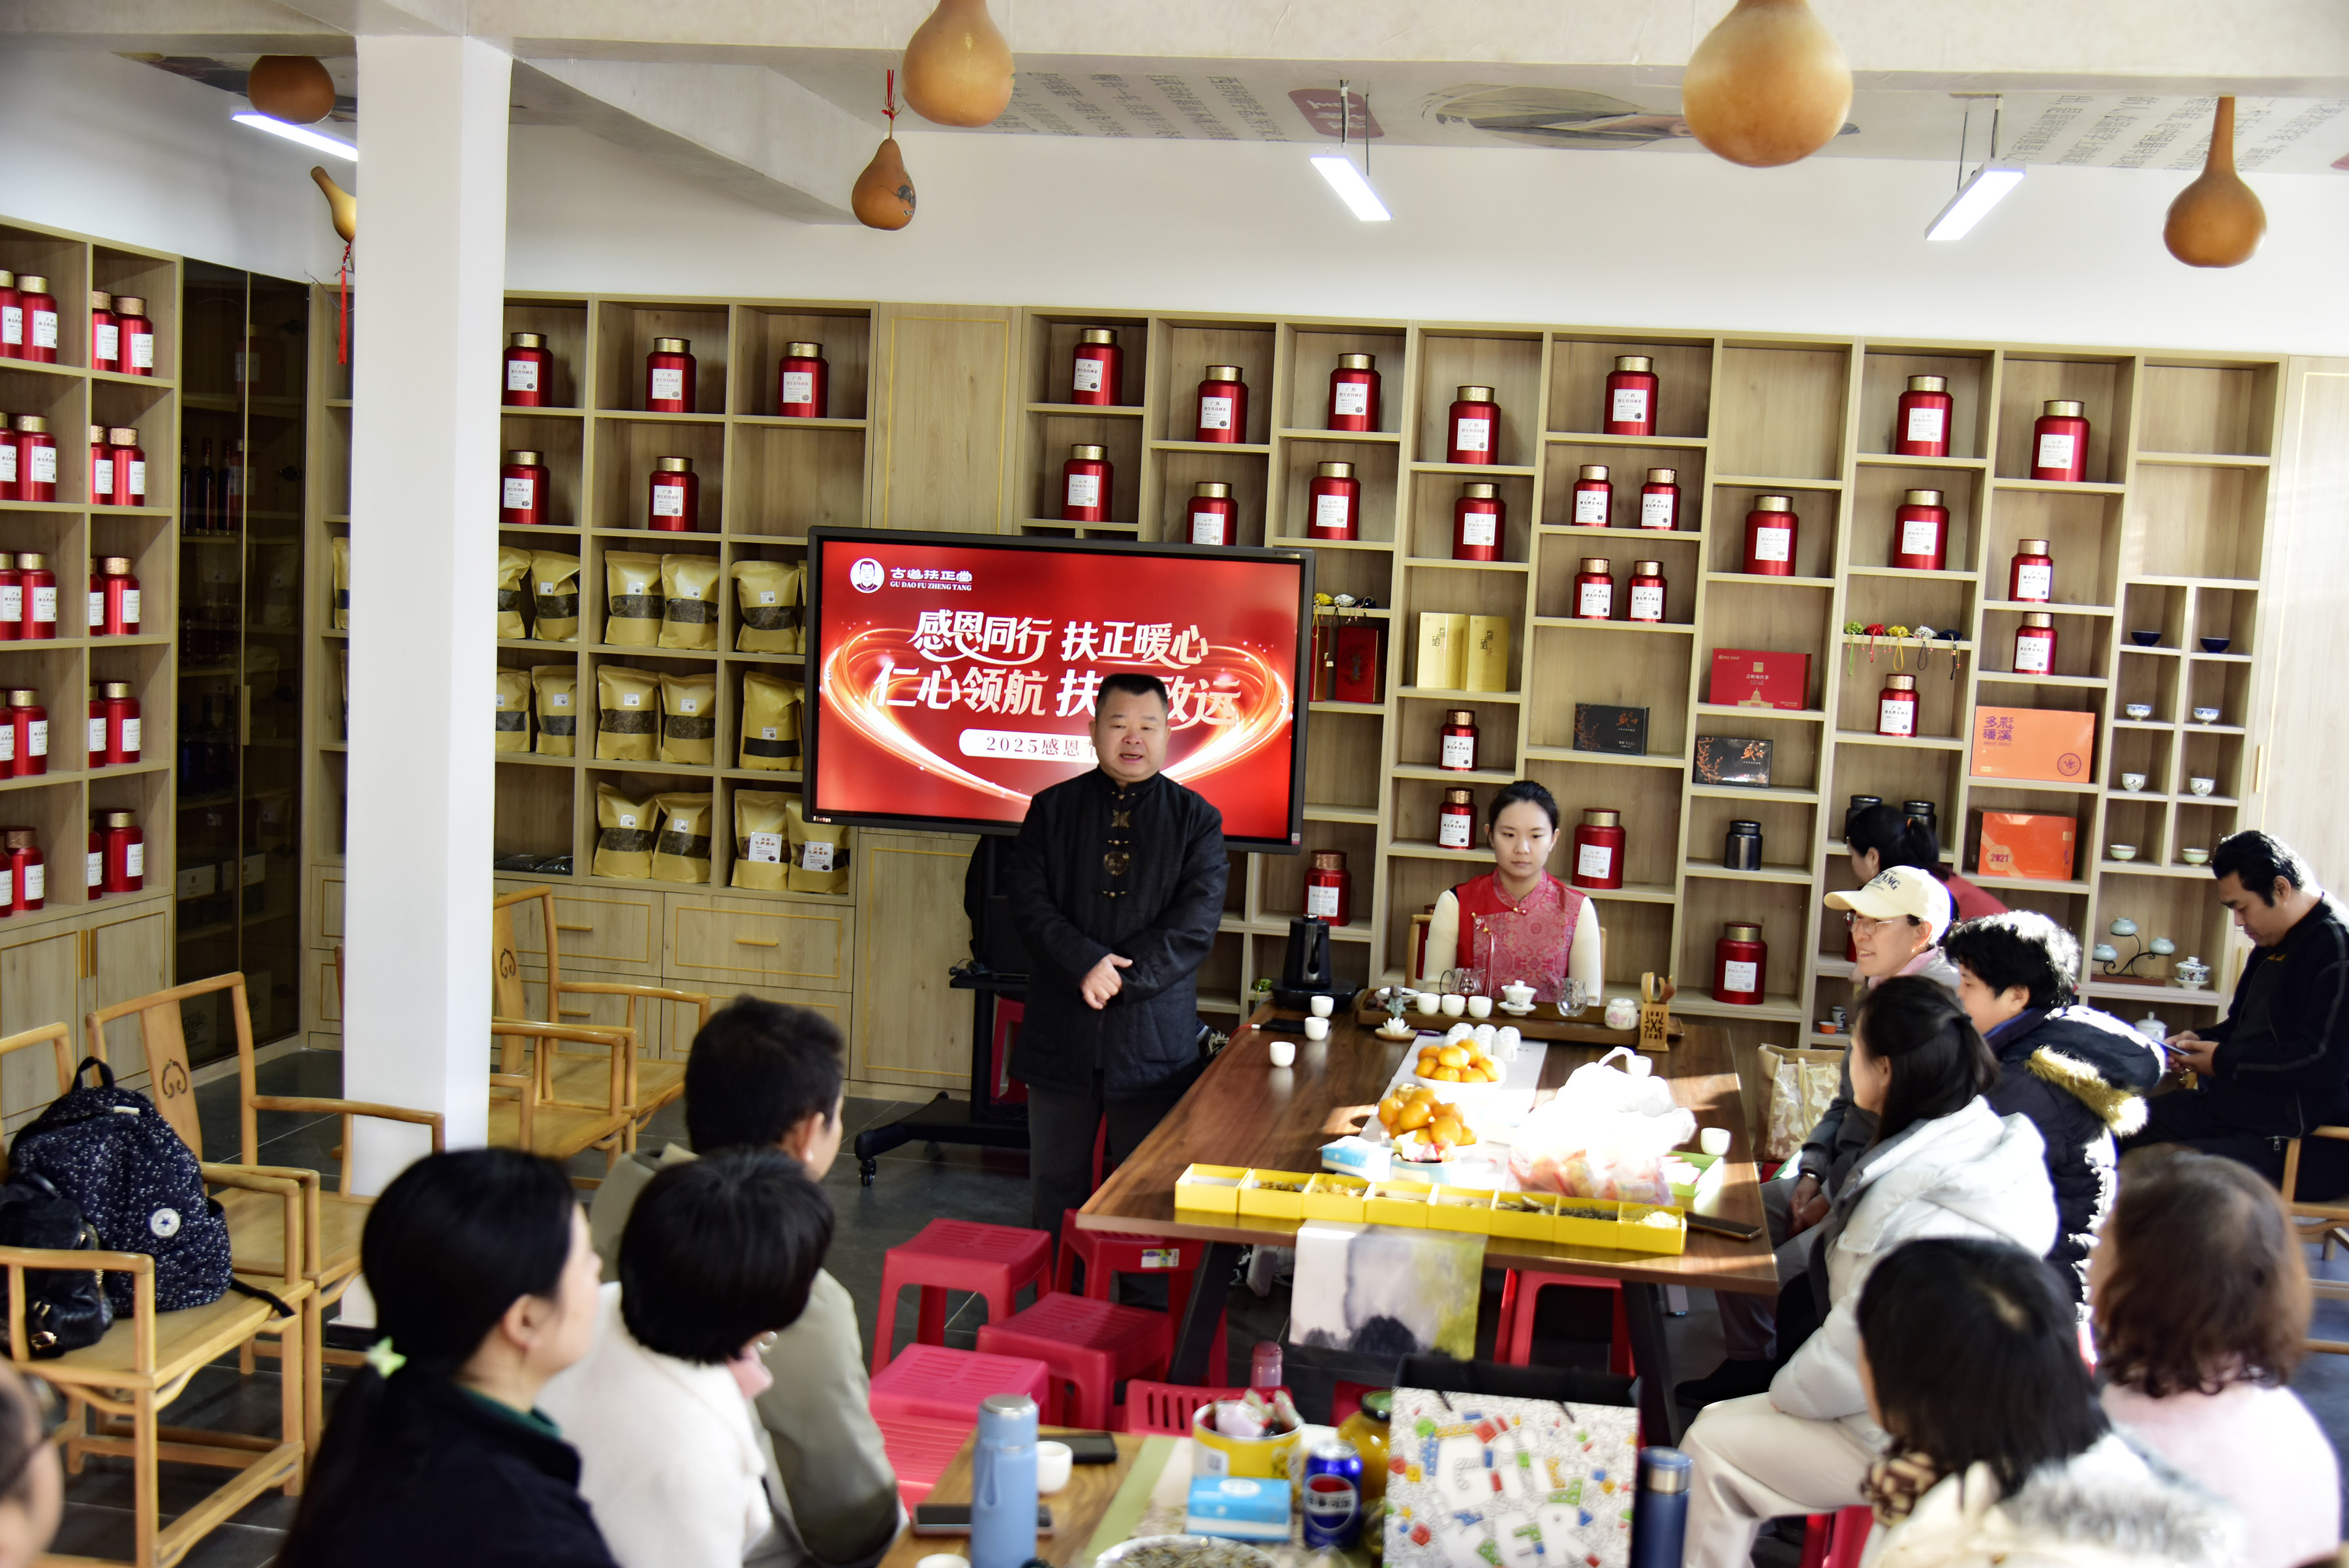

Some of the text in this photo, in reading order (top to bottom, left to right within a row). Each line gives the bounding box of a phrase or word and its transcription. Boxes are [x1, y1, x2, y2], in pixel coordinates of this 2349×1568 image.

[890, 567, 973, 582] 古道扶正堂
[906, 609, 1209, 669] 感恩同行 扶正暖心
[874, 660, 1242, 730] 仁心领航 扶致远
[1983, 715, 2014, 730] 多彩
